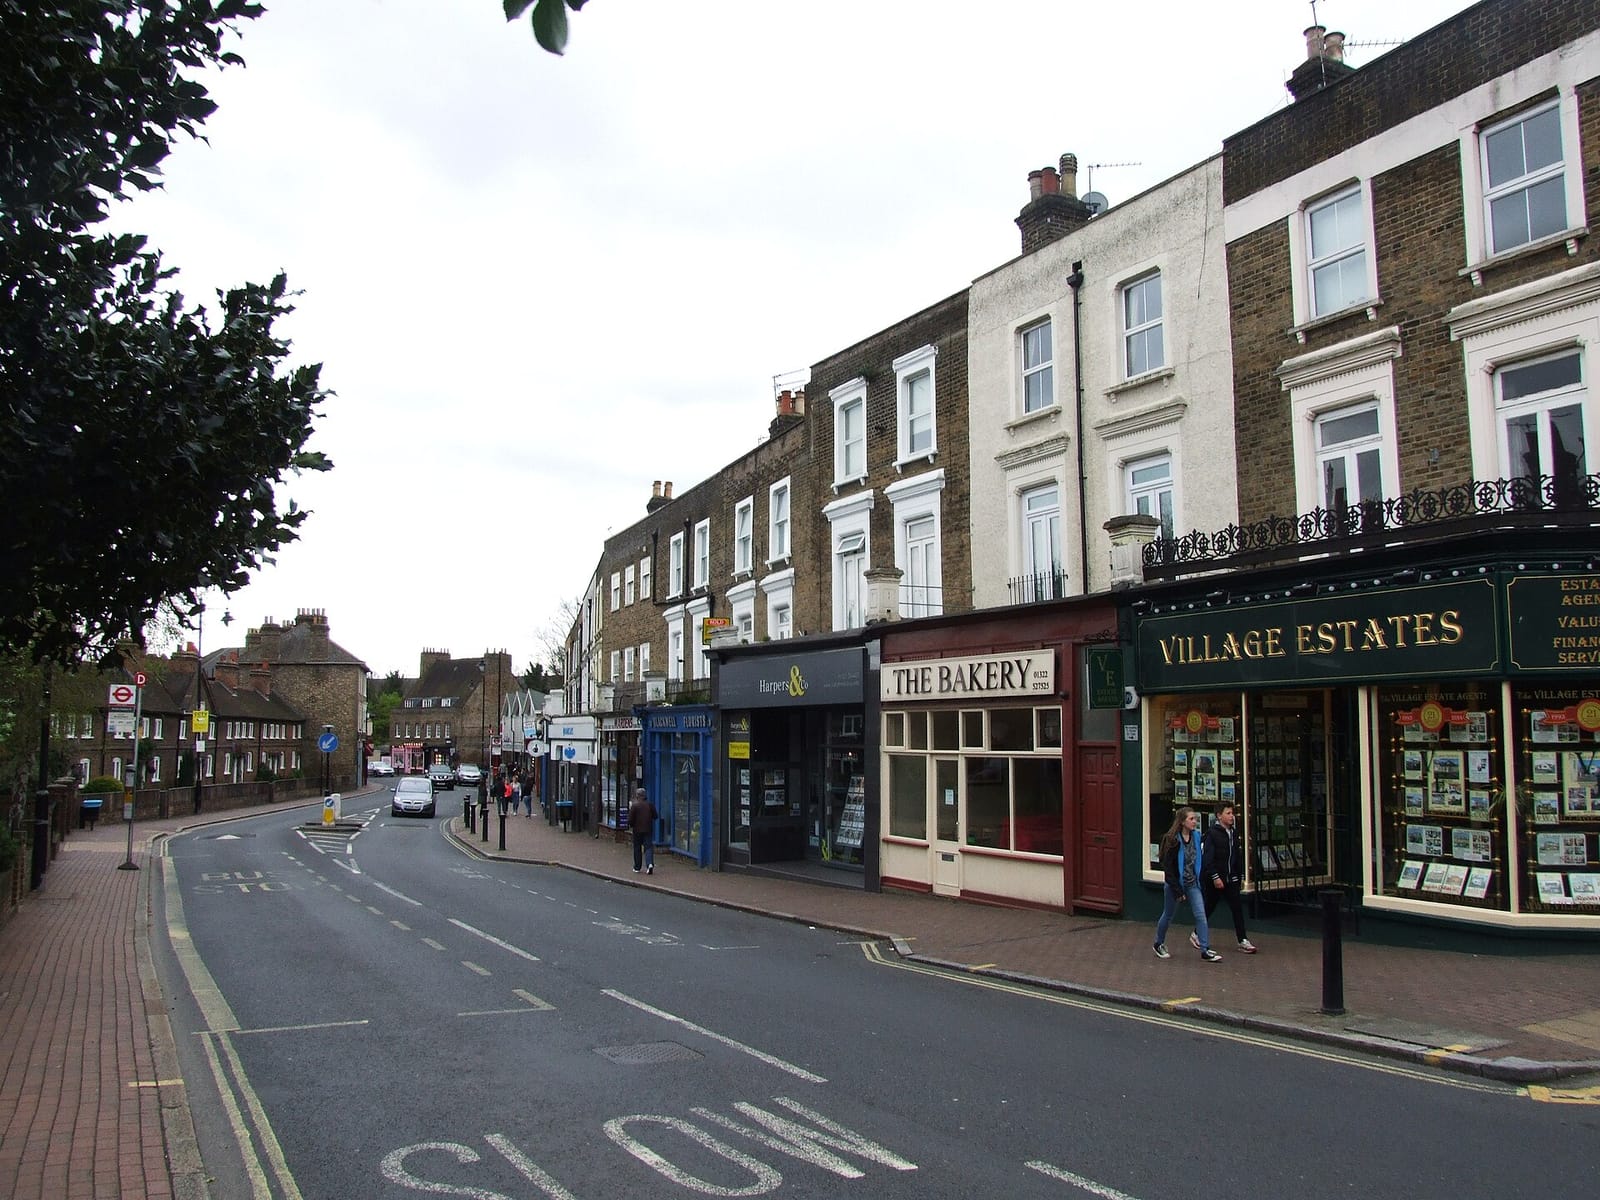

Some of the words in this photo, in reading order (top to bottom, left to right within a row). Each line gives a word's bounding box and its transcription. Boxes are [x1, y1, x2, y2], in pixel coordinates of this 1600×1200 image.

[1558, 616, 1600, 628] VALU
[1159, 627, 1287, 665] VILLAGE
[1296, 610, 1465, 655] ESTATES
[1553, 637, 1600, 649] FINAN
[137, 674, 146, 684] D
[893, 667, 932, 695] THE
[938, 658, 1032, 694] BAKERY
[1033, 670, 1049, 679] 01322
[759, 680, 790, 695] Harpers
[789, 665, 805, 697] &
[1534, 689, 1578, 700] VILLAGE
